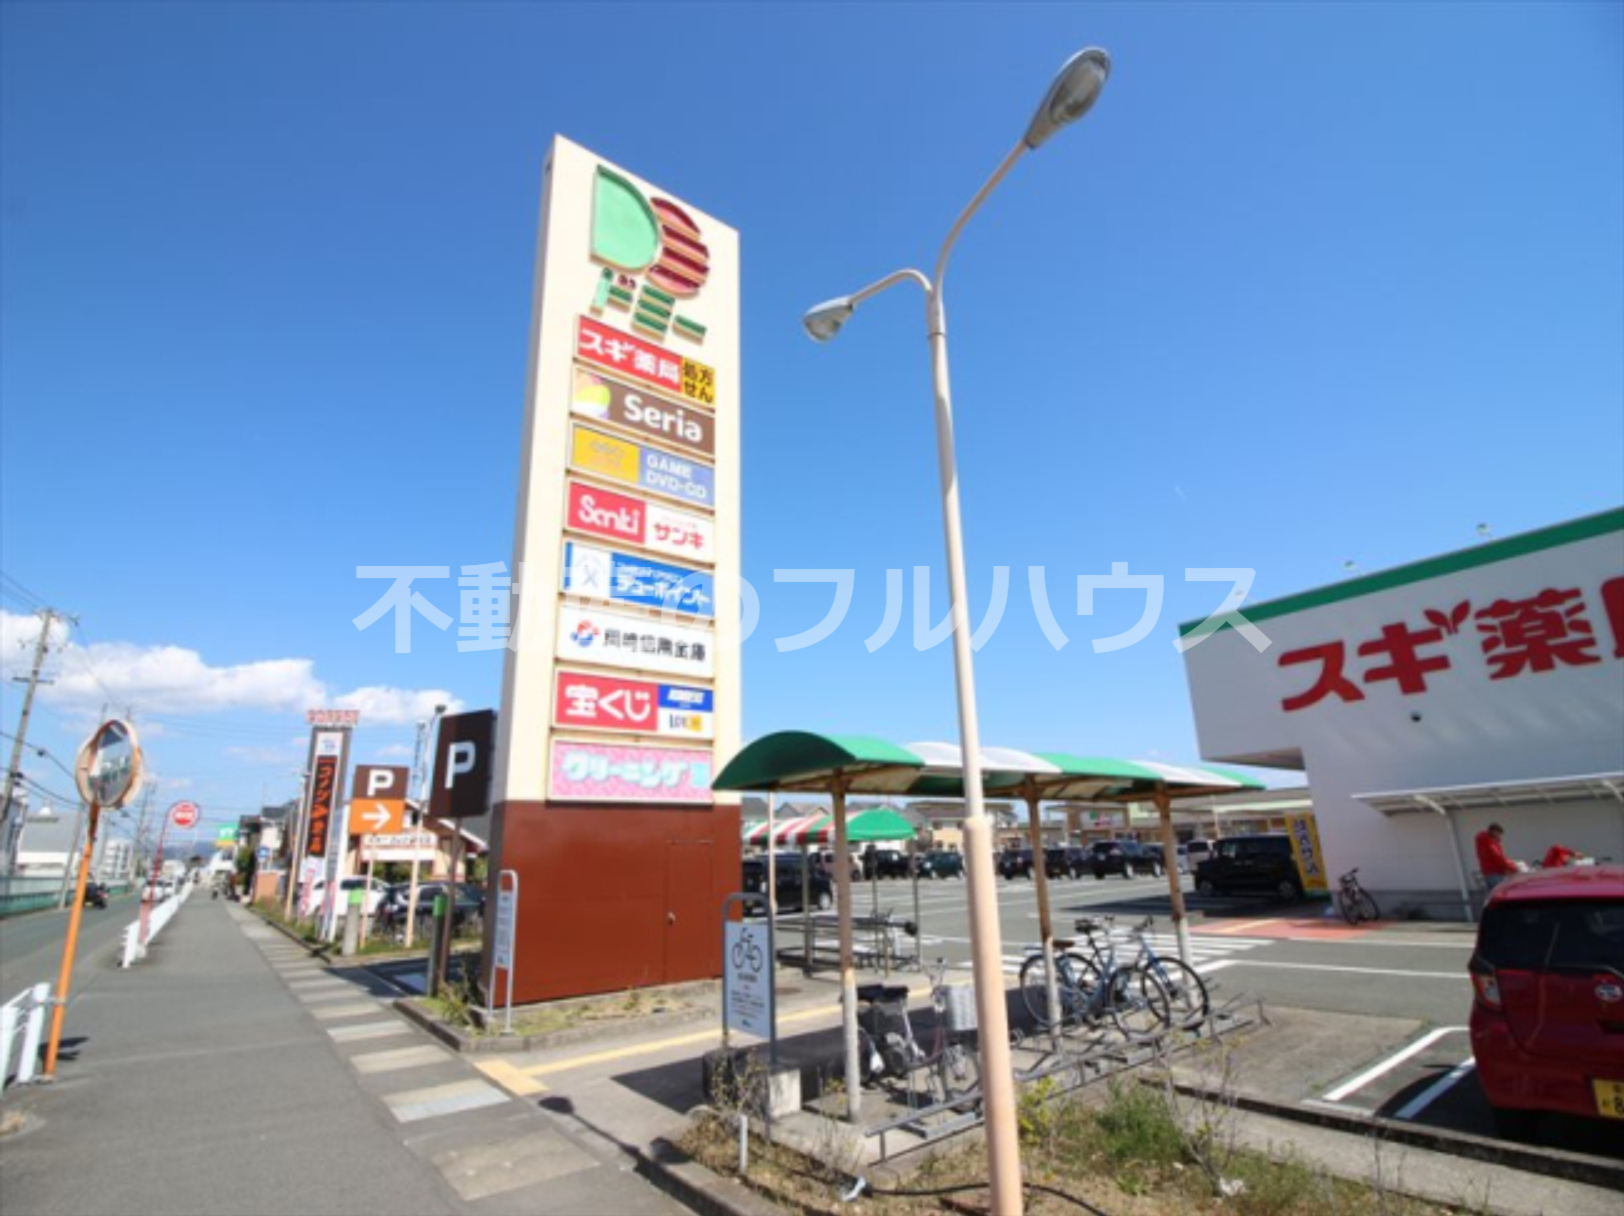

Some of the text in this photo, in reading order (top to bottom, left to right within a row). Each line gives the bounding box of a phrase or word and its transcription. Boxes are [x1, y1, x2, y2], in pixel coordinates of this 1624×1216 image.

[580, 328, 680, 383] スギ薬局
[624, 394, 703, 443] Seria
[646, 454, 692, 479] GAME
[654, 522, 705, 550] サンキ
[564, 684, 651, 722] 宝くじ
[367, 769, 395, 797] P
[445, 741, 477, 789] P
